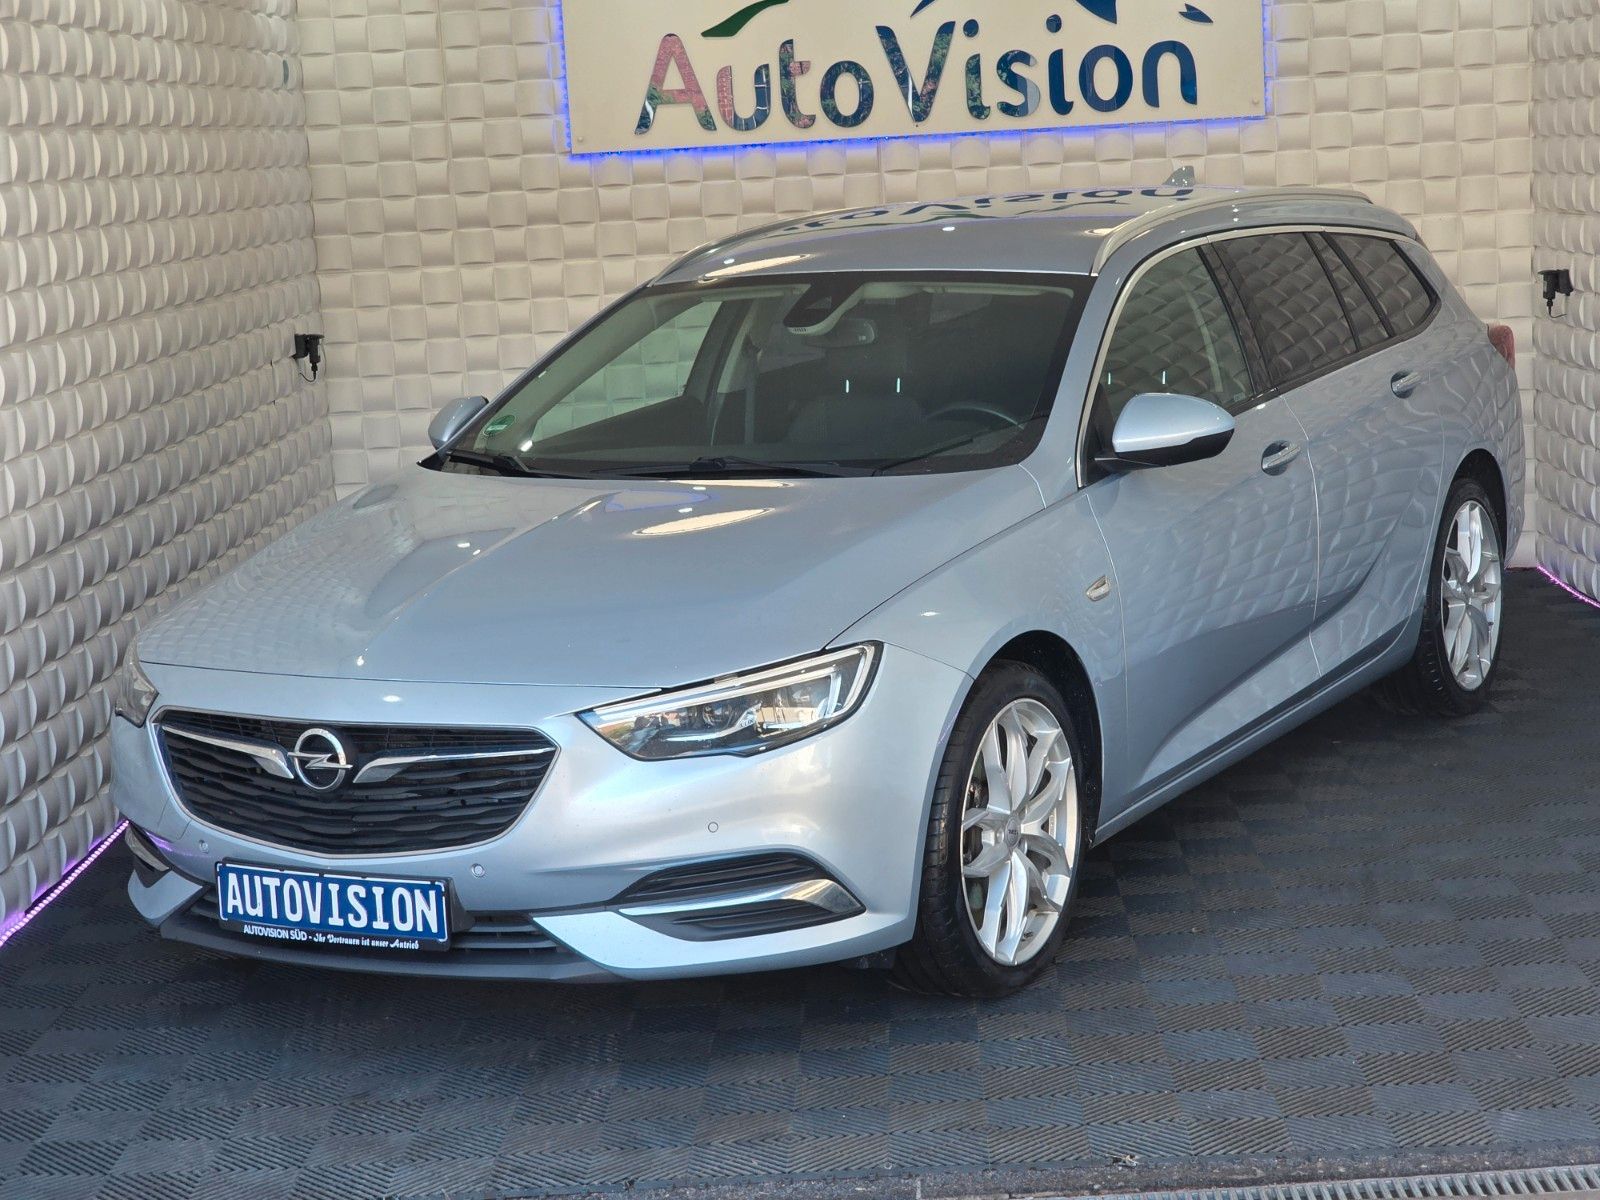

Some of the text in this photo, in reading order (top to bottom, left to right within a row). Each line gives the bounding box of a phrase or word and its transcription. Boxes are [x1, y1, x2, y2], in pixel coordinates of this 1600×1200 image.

[634, 14, 1199, 136] AutoVision
[226, 872, 438, 934] AUTOVISION
[243, 924, 290, 940] AUTOVISION
[289, 928, 308, 941] SÜD
[313, 932, 326, 943] Ihr
[326, 933, 360, 946] Vertrauen
[361, 936, 370, 946] ist
[371, 939, 389, 948] unser
[389, 938, 419, 950] Antrieb
